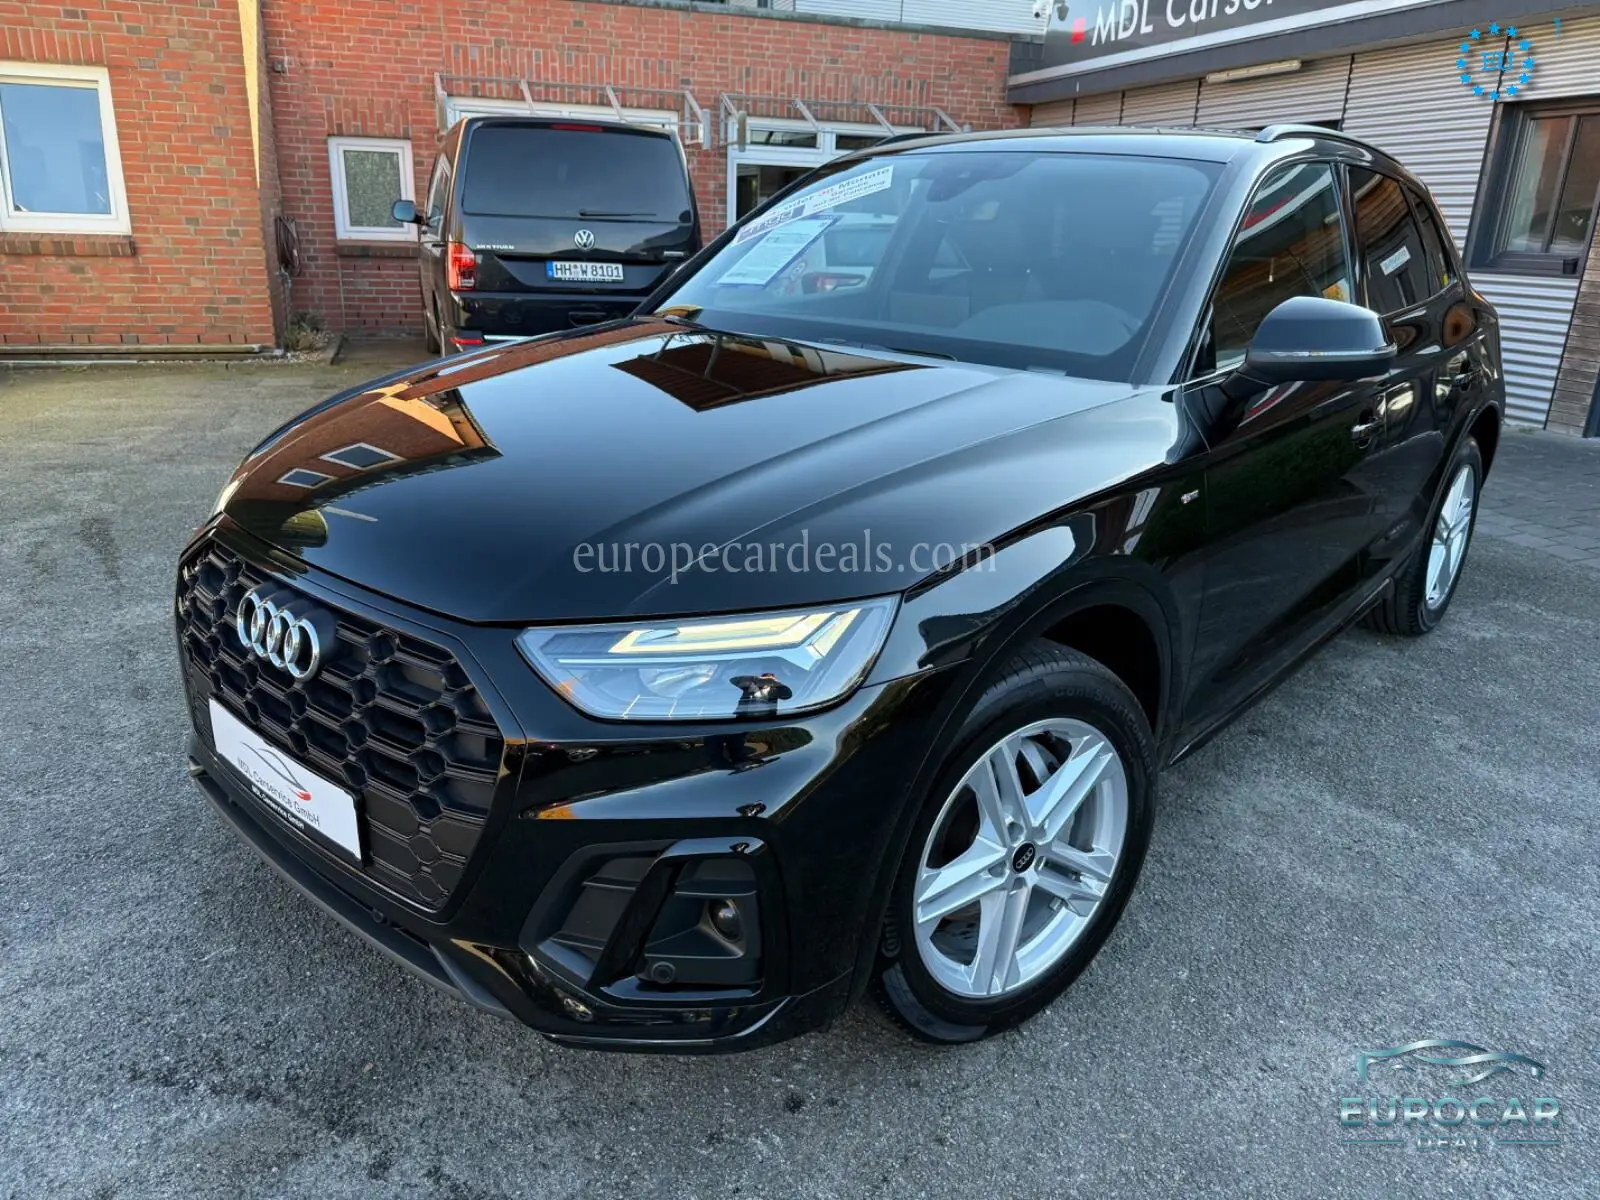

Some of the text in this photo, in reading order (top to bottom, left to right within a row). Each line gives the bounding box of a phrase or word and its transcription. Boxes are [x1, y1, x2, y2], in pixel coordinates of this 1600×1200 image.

[1091, 0, 1154, 46] MDL
[555, 263, 622, 278] HH W 8101
[253, 768, 294, 809] Carservice
[294, 801, 321, 827] GmbH
